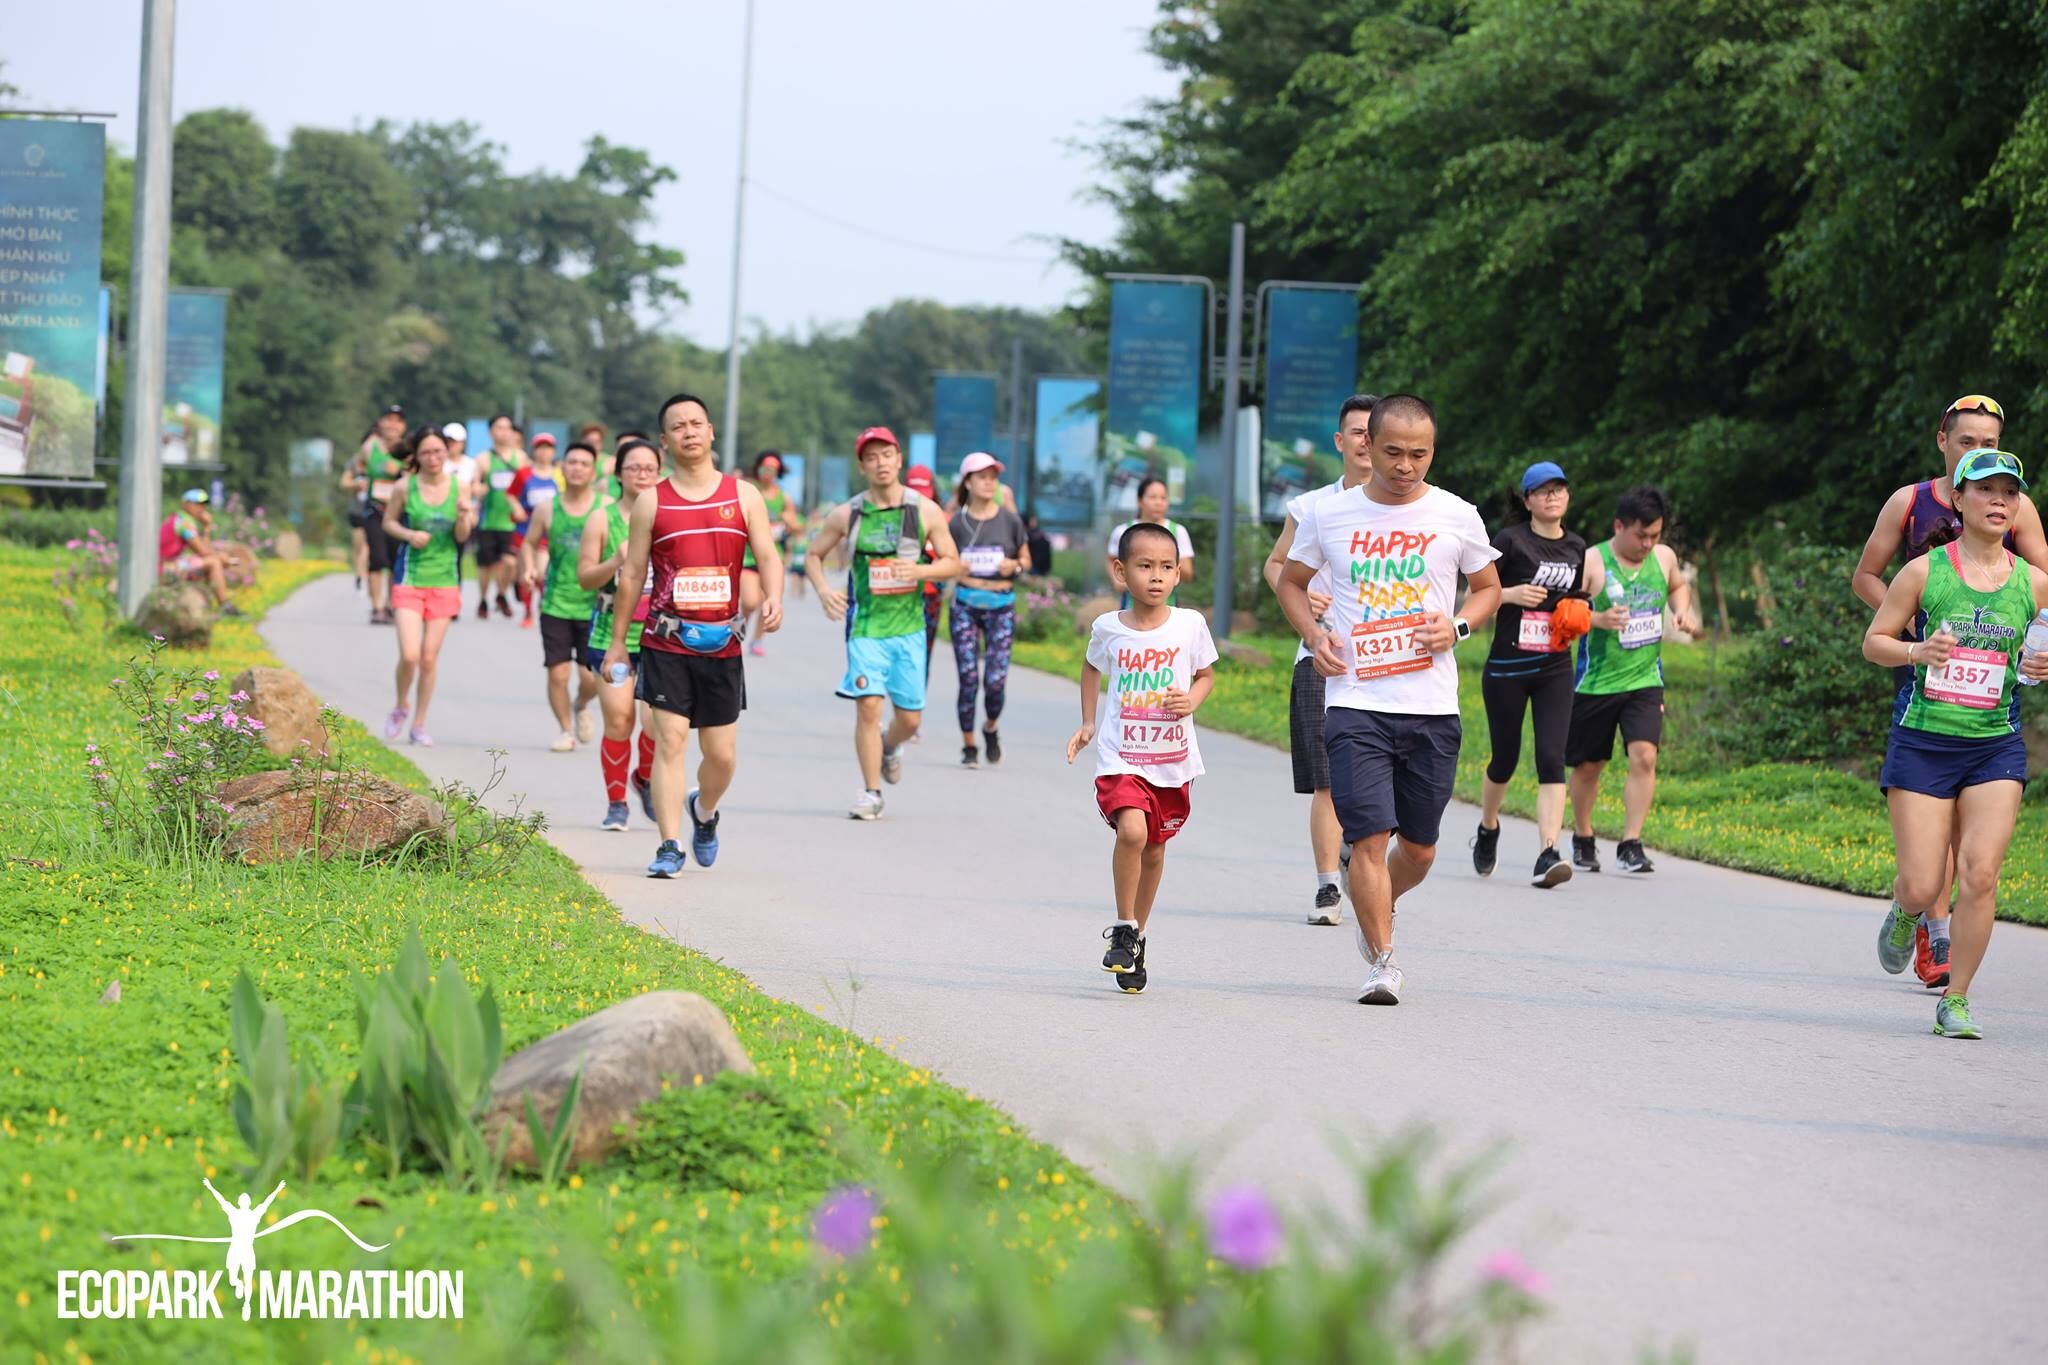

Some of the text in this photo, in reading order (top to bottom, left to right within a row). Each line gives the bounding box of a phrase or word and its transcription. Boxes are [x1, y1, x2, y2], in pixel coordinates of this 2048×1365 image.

[1350, 530, 1437, 558] HAPPY
[1351, 555, 1425, 584] MIND
[1531, 565, 1576, 590] RUN
[677, 581, 726, 593] M8649
[1358, 580, 1431, 610] HAPPY
[1622, 619, 1655, 633] 6050
[1979, 623, 2016, 639] MARATHON
[1356, 632, 1416, 657] K3217
[1957, 636, 1999, 650] 2019
[1118, 647, 1180, 672] HAPPY
[1117, 667, 1174, 692] MIND
[1943, 664, 1990, 685] 1357
[1123, 724, 1184, 742] K1740
